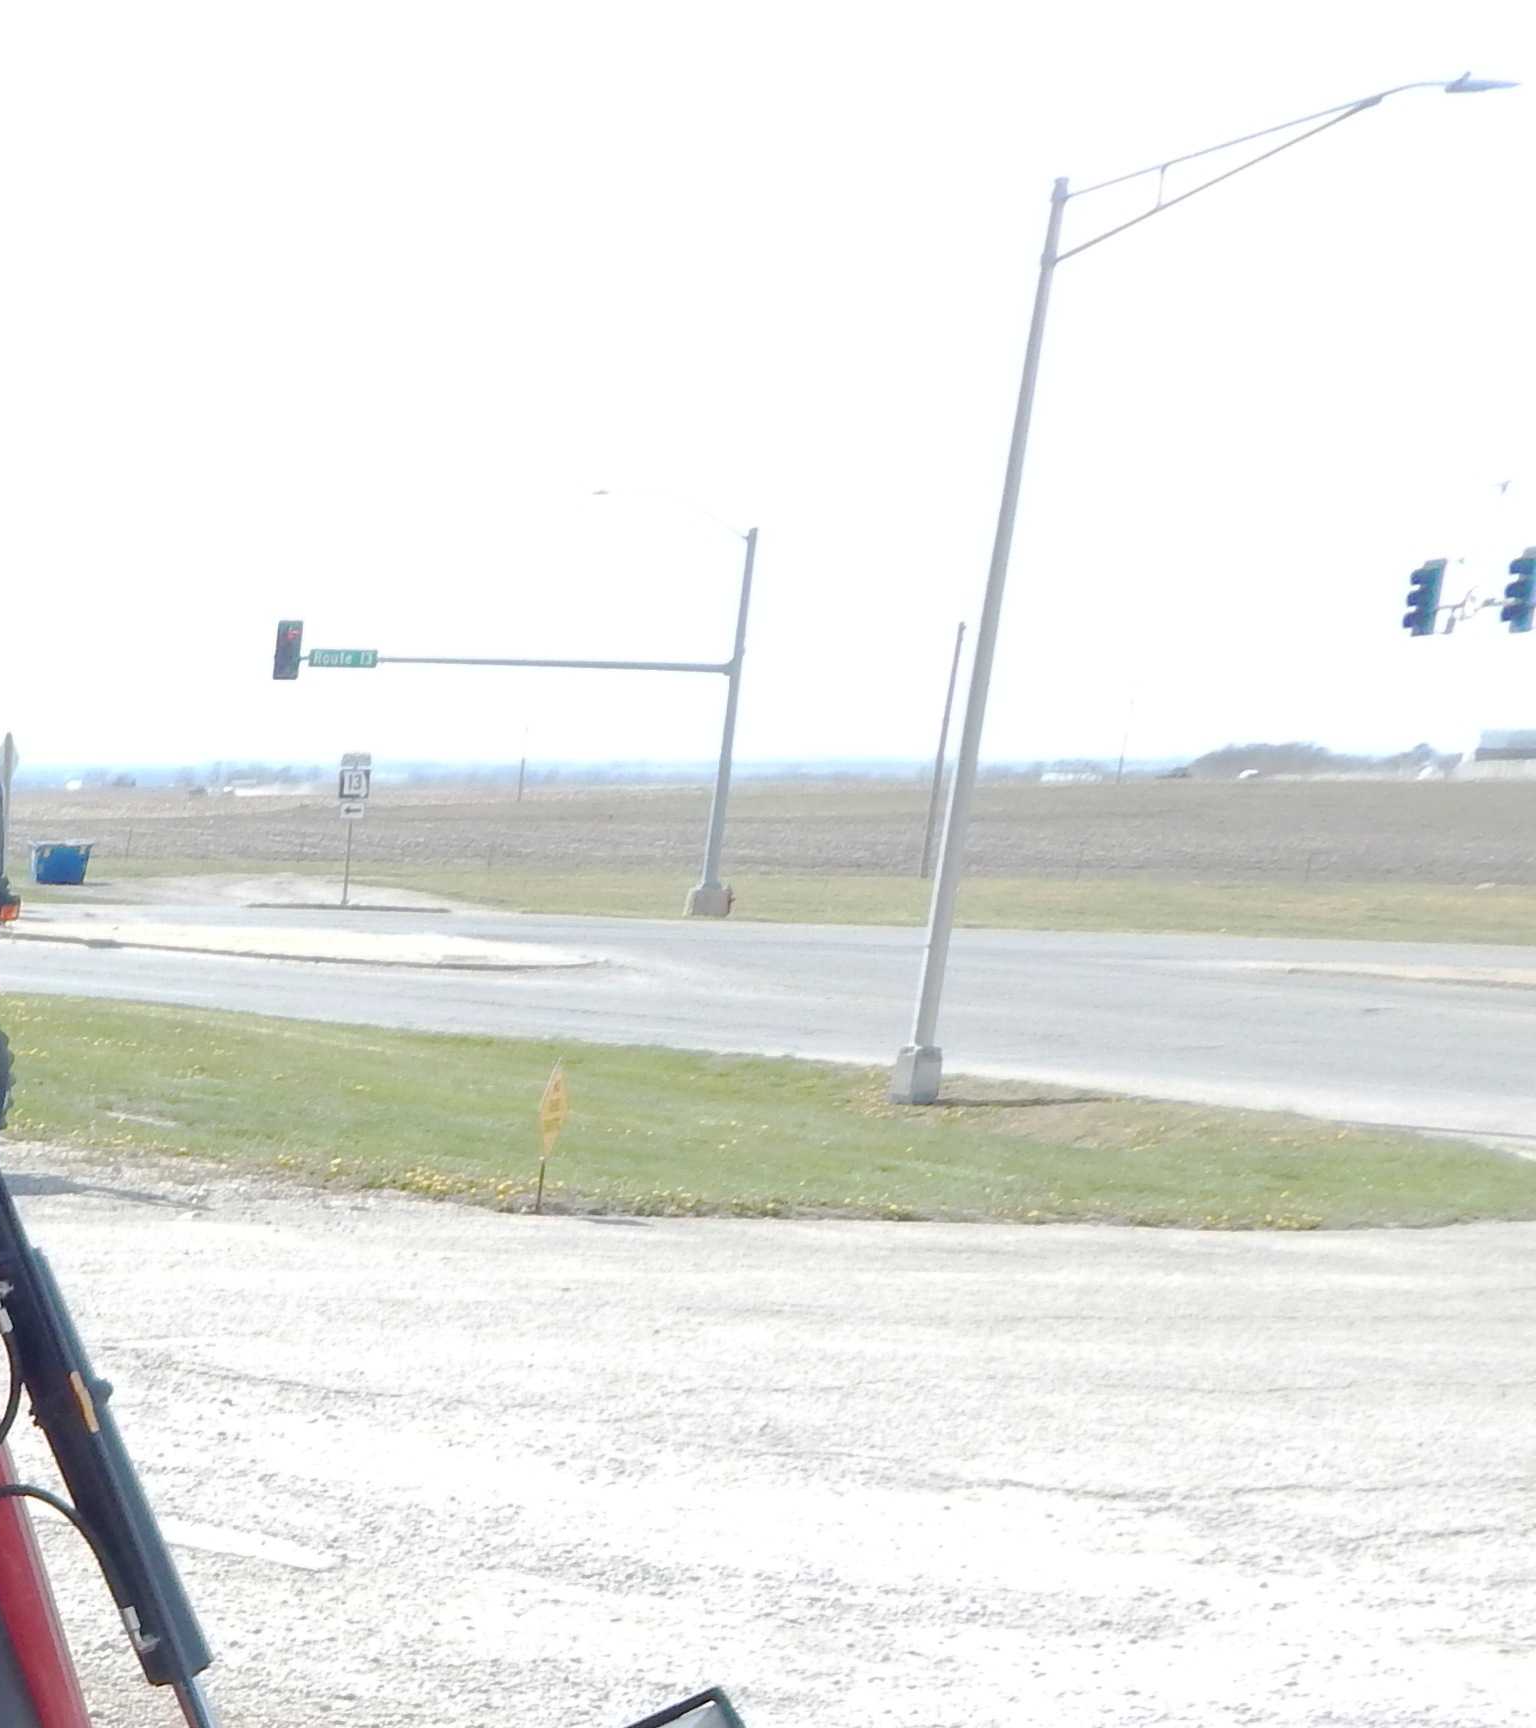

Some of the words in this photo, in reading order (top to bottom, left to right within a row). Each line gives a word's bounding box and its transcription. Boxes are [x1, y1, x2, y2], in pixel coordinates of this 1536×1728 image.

[313, 650, 353, 665] Route
[360, 651, 374, 665] 13
[348, 773, 363, 791] 13
